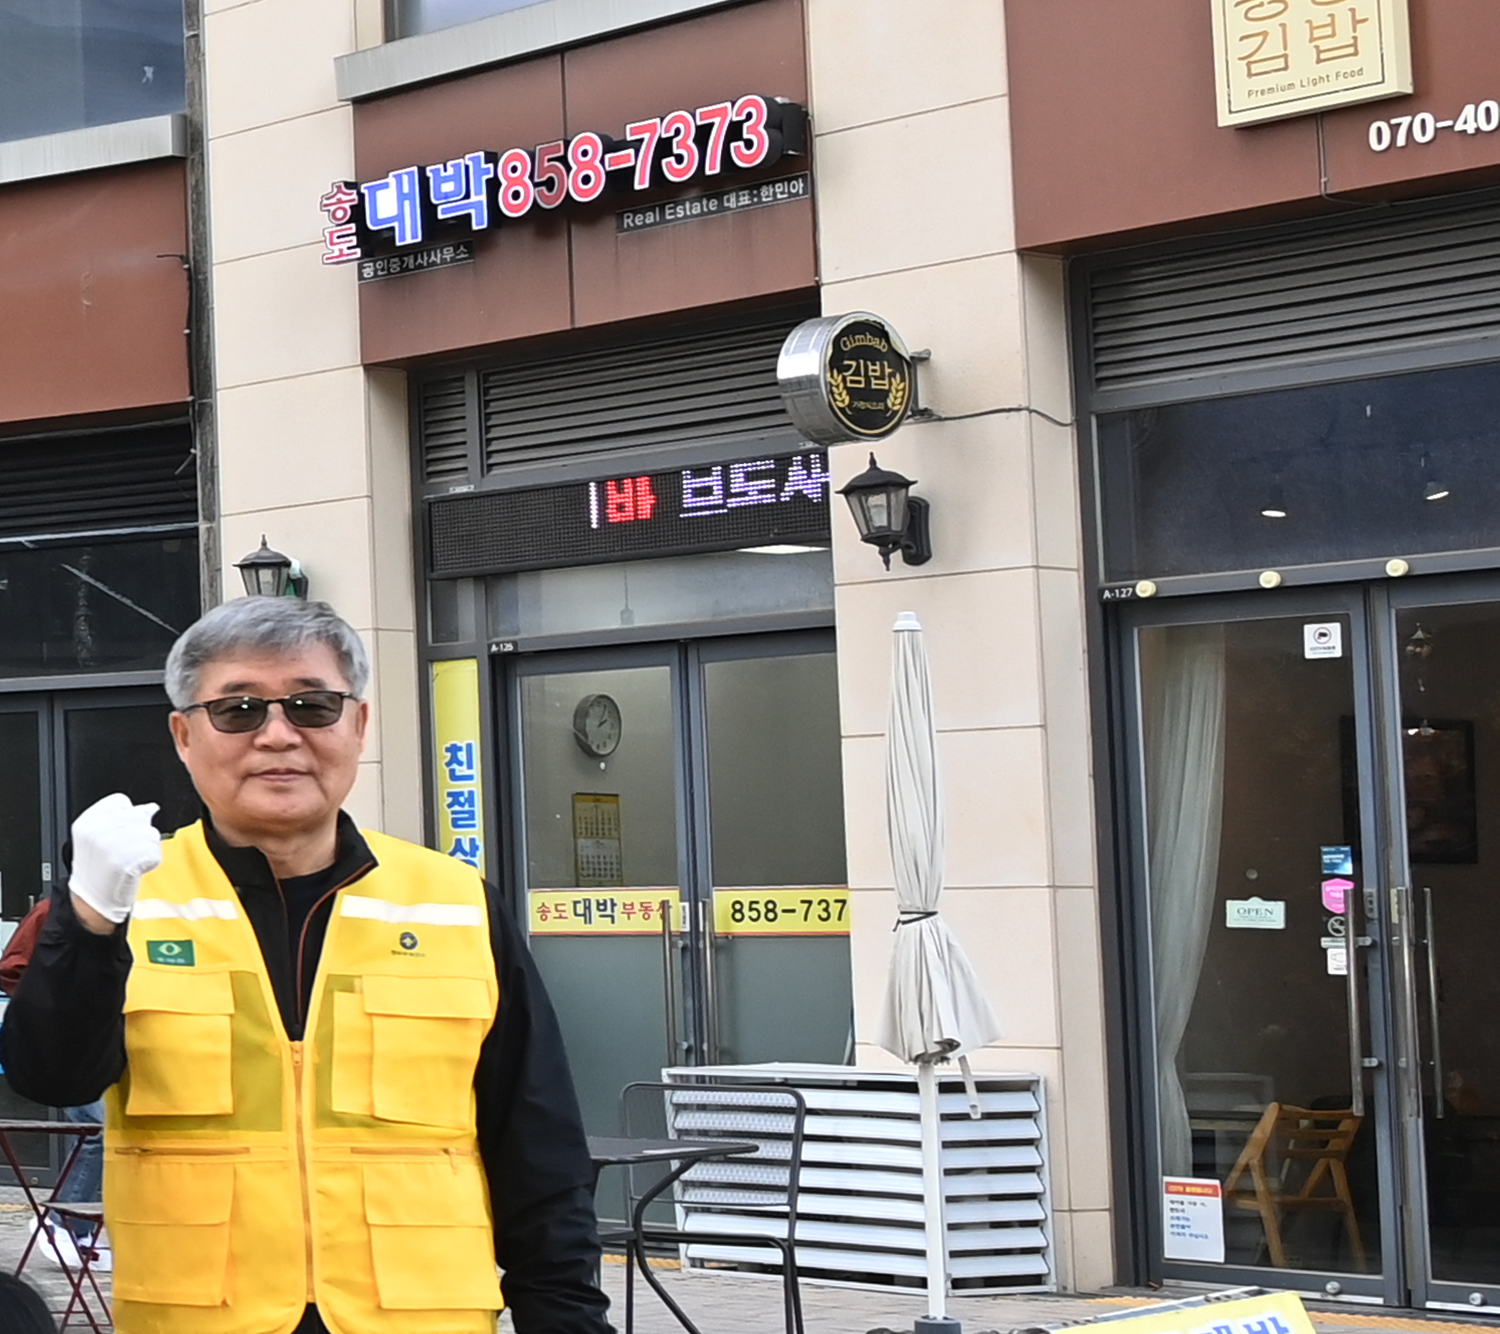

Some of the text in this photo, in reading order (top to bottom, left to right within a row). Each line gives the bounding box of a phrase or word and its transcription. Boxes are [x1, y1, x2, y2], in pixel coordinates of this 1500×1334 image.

[1236, 7, 1370, 80] 김밥
[1247, 67, 1365, 99] Premium Light Food
[497, 94, 770, 219] 858-7373
[318, 181, 361, 265] 송도
[622, 208, 662, 229] Real
[664, 197, 719, 222] Estate
[840, 333, 888, 353] Gimbab
[842, 359, 896, 390] 김밥
[1102, 587, 1134, 600] A-127
[1236, 907, 1275, 917] OPEN
